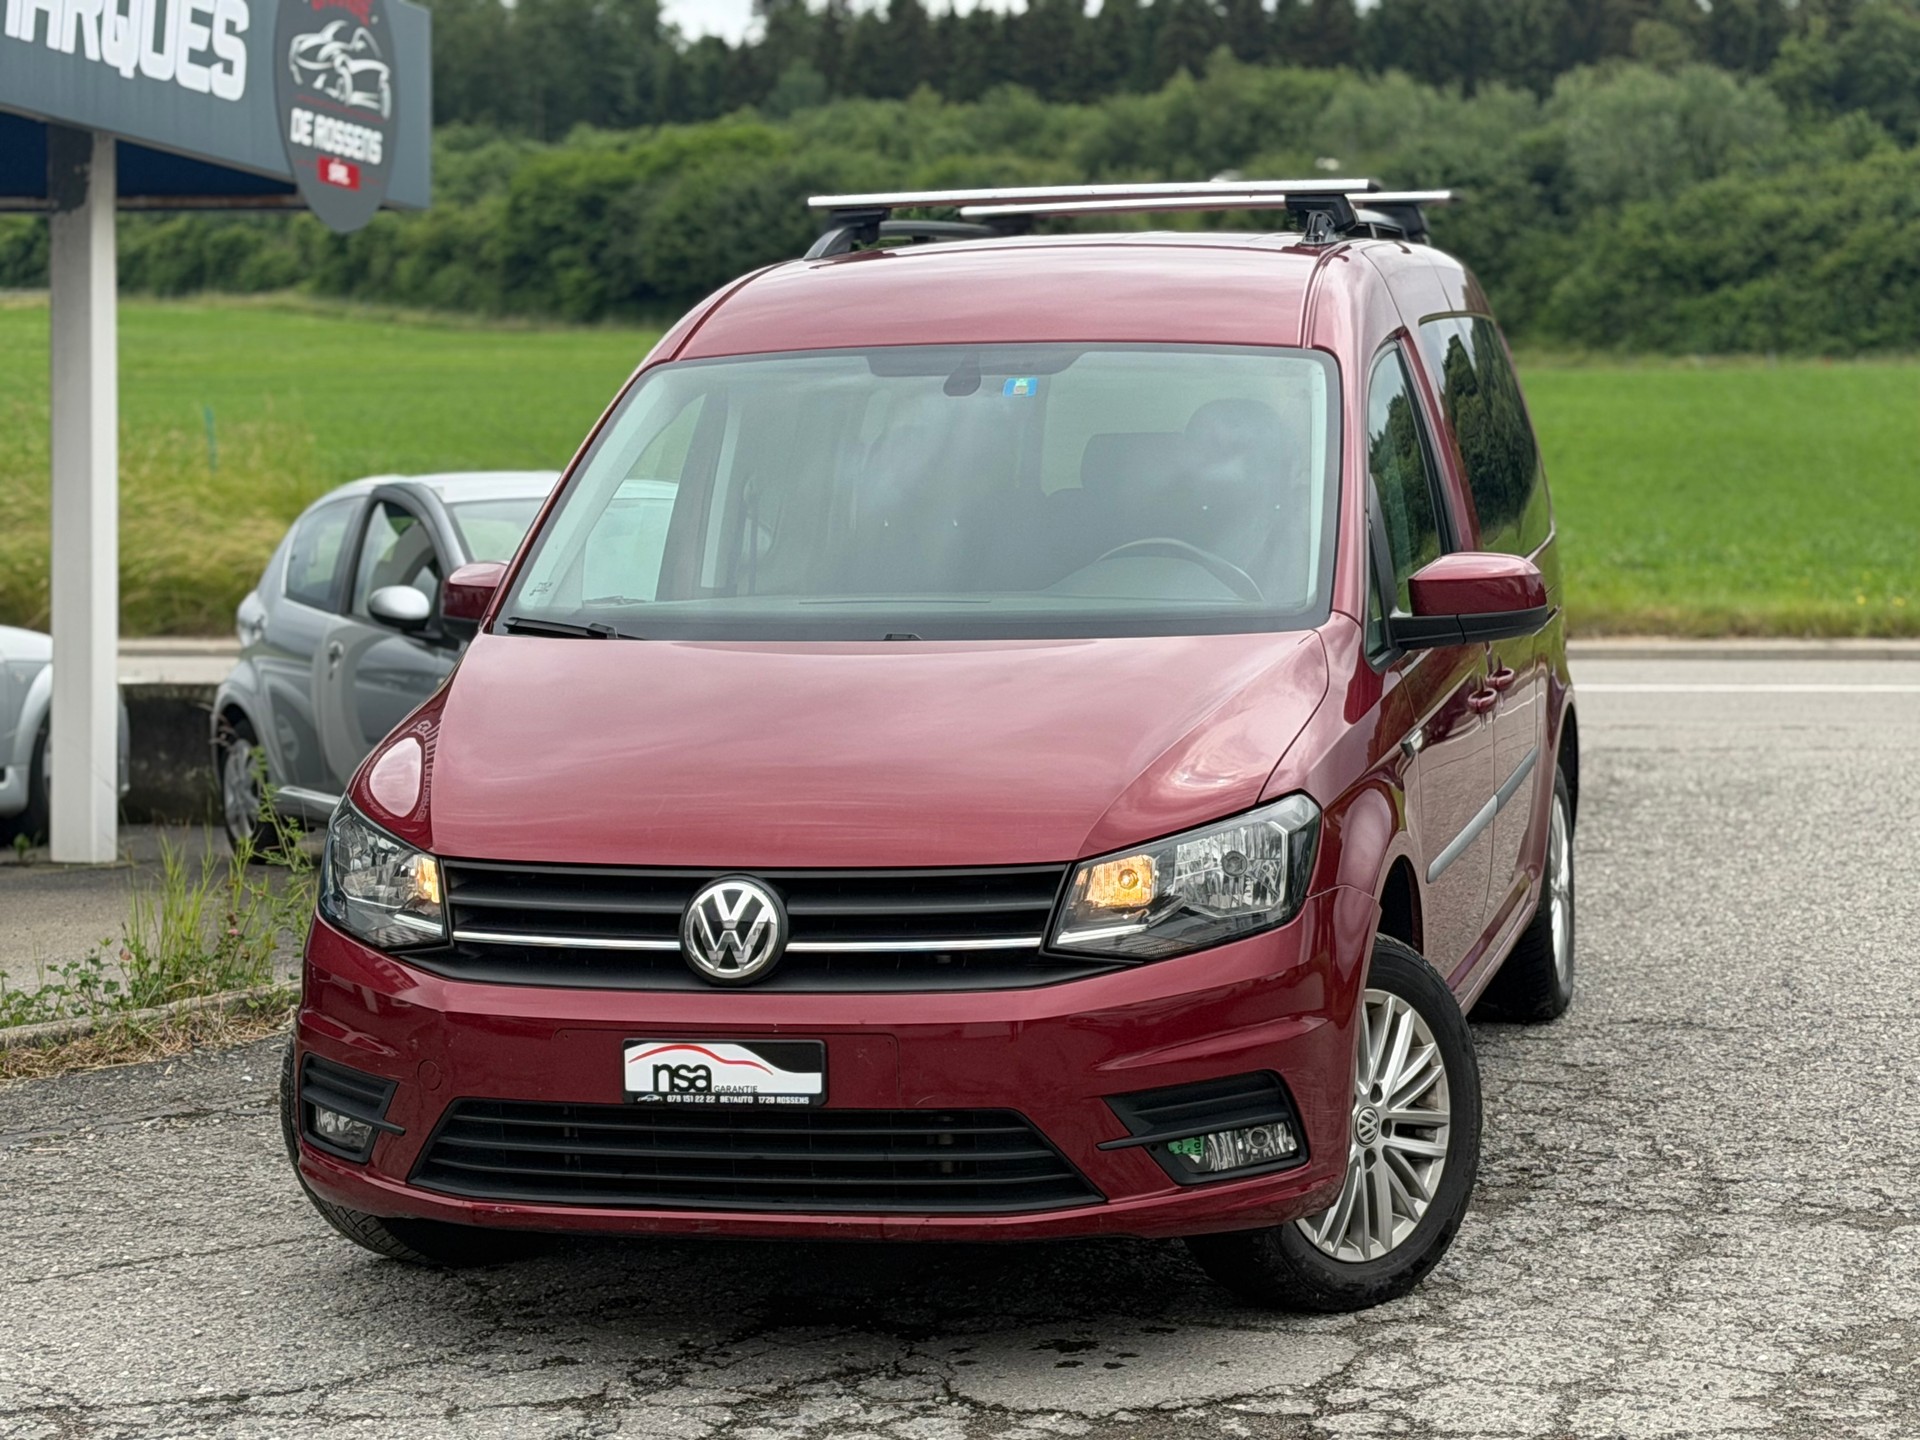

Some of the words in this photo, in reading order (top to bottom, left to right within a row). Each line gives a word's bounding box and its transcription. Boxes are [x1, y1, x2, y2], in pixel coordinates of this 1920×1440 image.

[4, 0, 249, 101] ARQUES
[291, 107, 314, 146] DE
[313, 113, 383, 165] ROSSENS
[652, 1064, 713, 1093] nsa
[713, 1085, 759, 1094] GARANTIE
[682, 1094, 694, 1103] 151
[694, 1095, 705, 1103] 22
[705, 1095, 716, 1103] 22
[719, 1095, 754, 1104] BEYAUTO
[776, 1096, 810, 1105] ROSSENS
